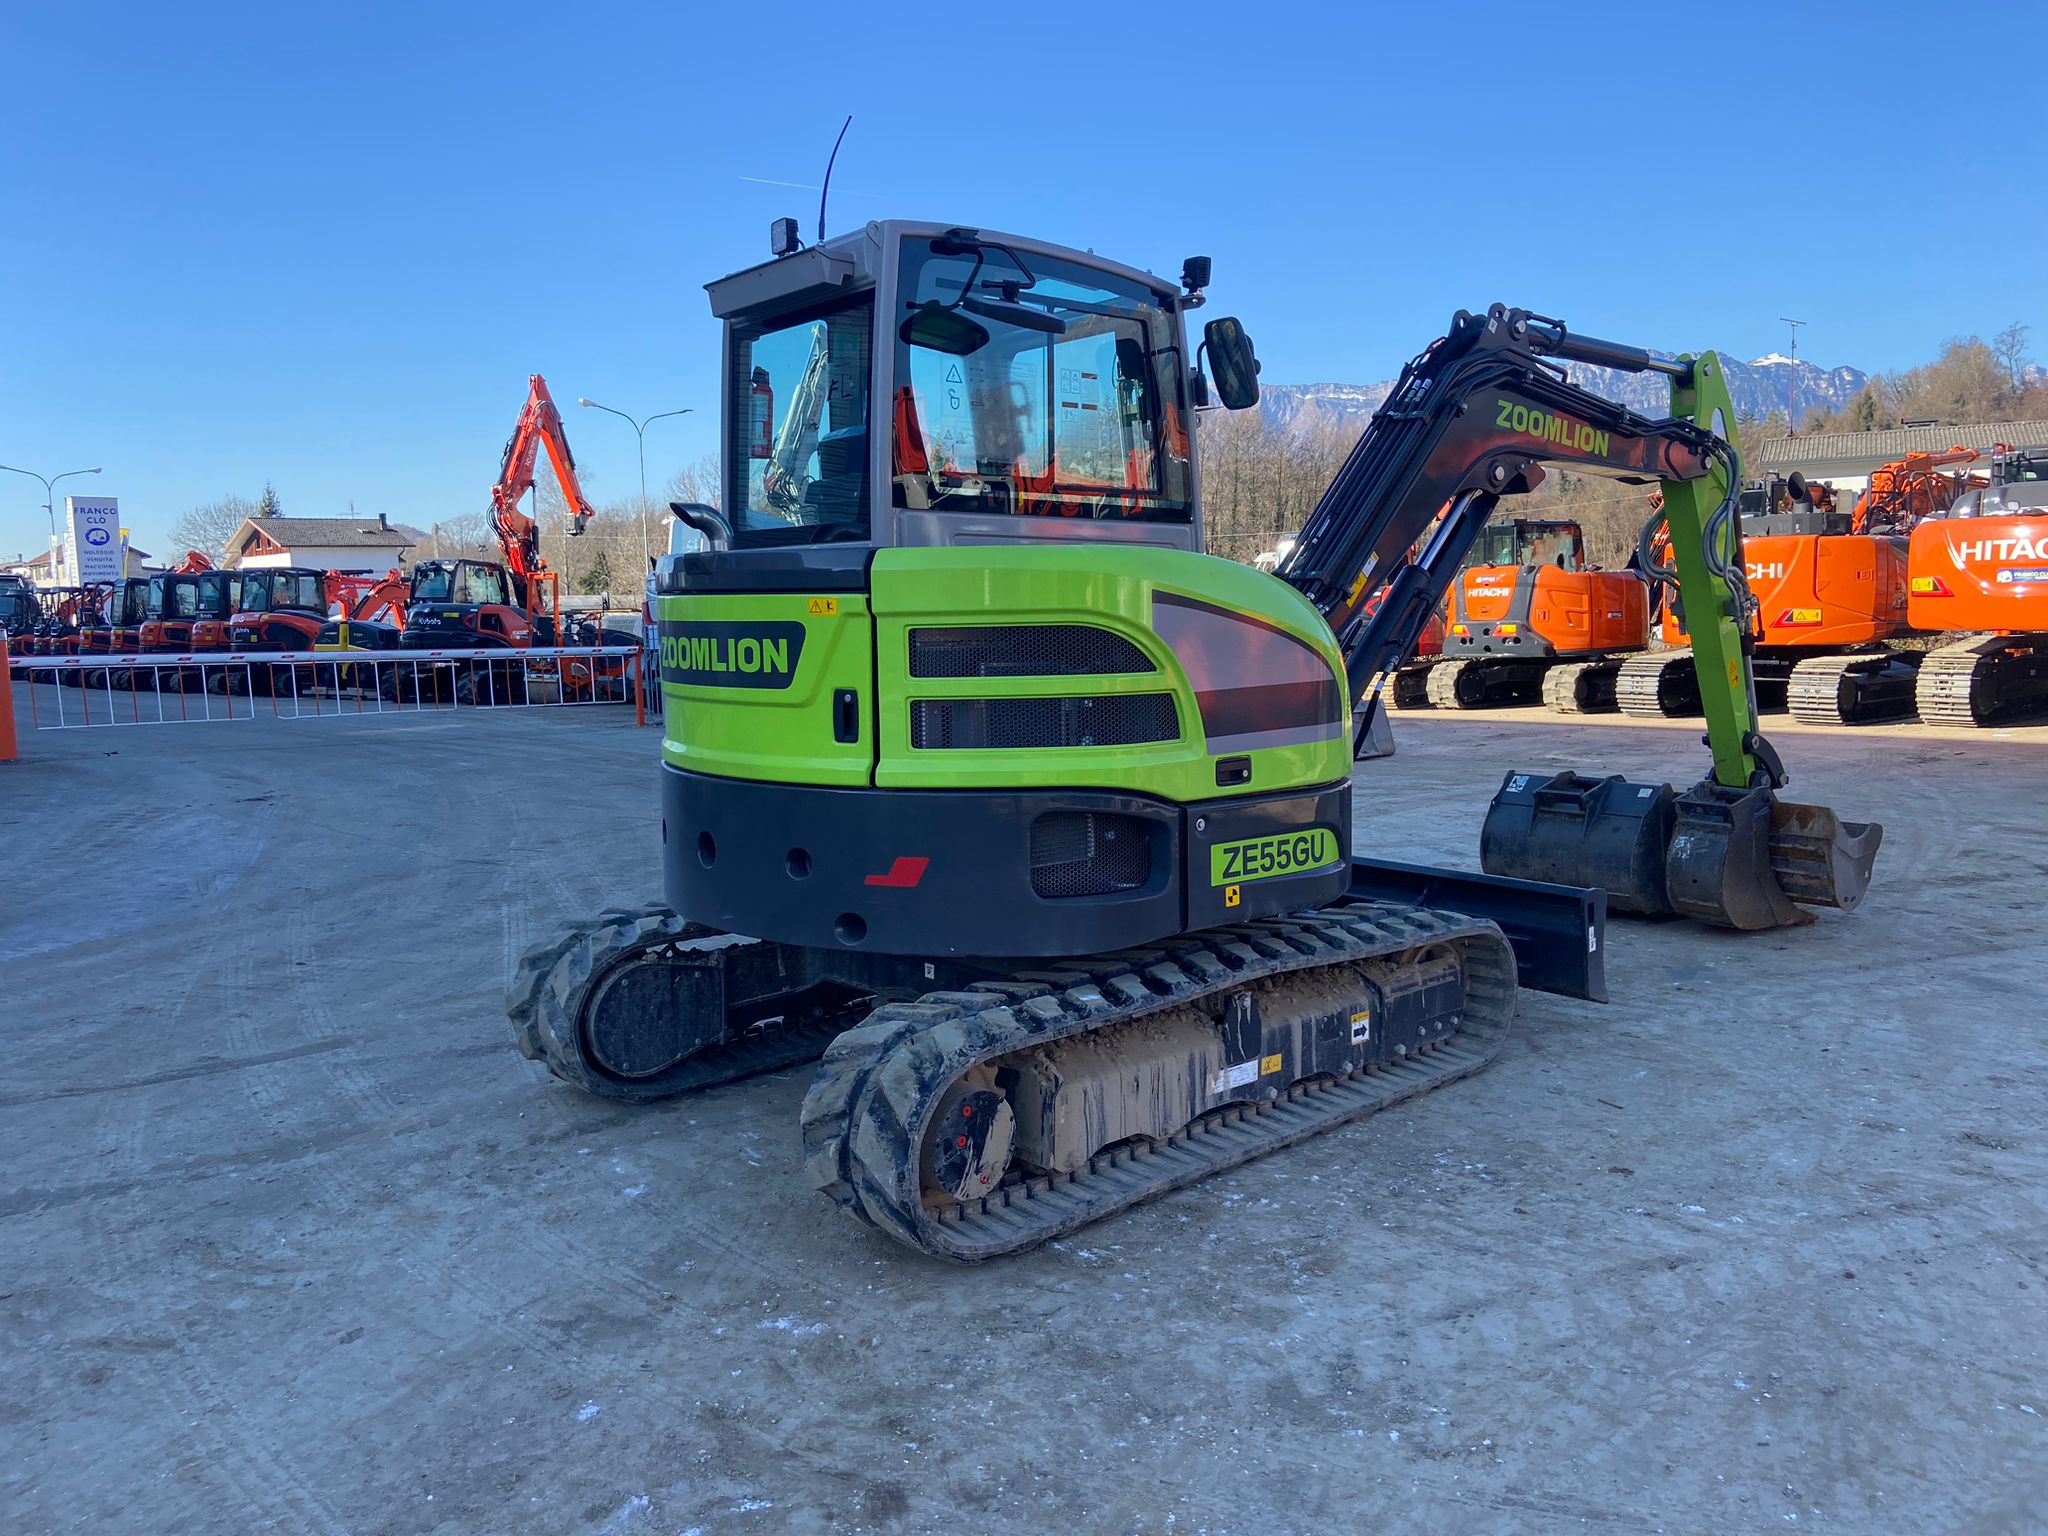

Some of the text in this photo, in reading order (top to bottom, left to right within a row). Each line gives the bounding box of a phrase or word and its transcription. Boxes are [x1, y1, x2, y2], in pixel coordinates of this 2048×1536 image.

[1496, 399, 1610, 457] ZOOMLION
[74, 507, 117, 515] FRANCO
[86, 516, 106, 524] CLO
[1468, 587, 1509, 597] HITACHI
[418, 617, 442, 625] Kubota
[661, 636, 789, 674] ZOOMLION
[1222, 832, 1325, 880] ZE55GU
